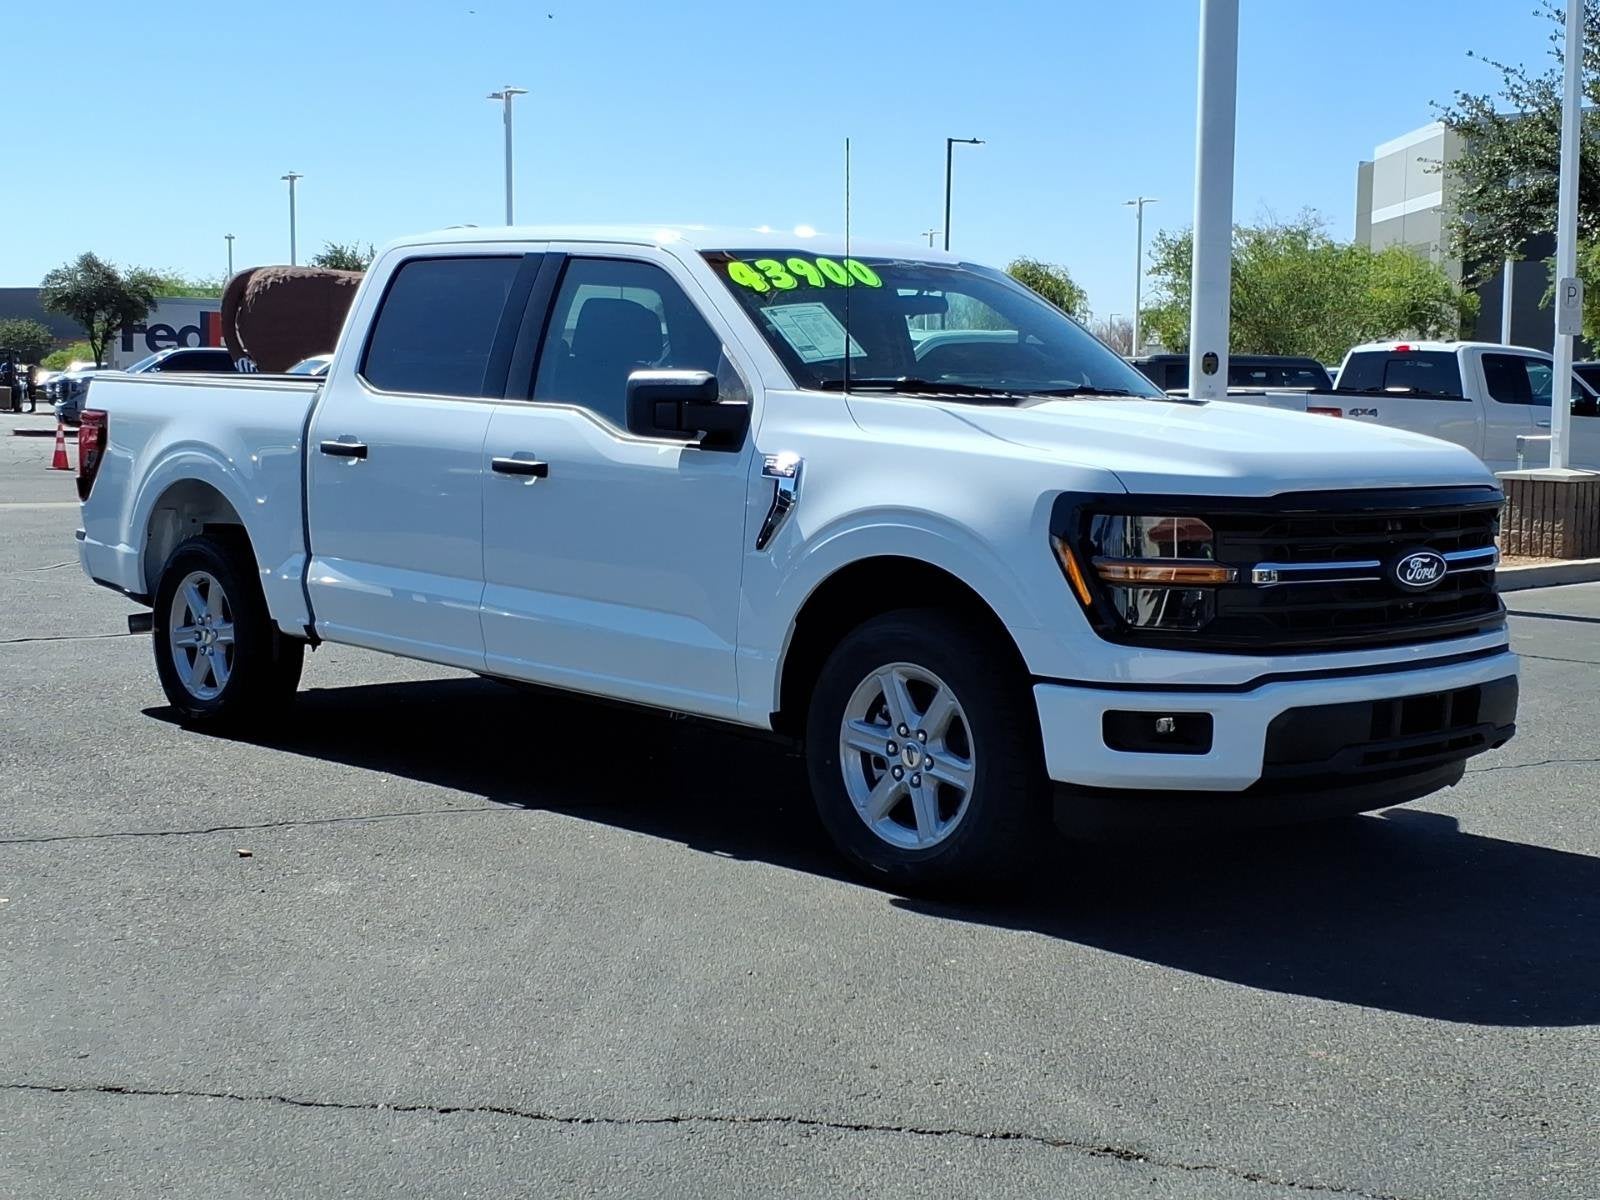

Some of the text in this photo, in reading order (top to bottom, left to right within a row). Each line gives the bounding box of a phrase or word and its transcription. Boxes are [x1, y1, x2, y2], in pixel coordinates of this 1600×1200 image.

[728, 257, 882, 292] 43900
[1567, 286, 1577, 305] P
[1406, 557, 1438, 580] Ford
